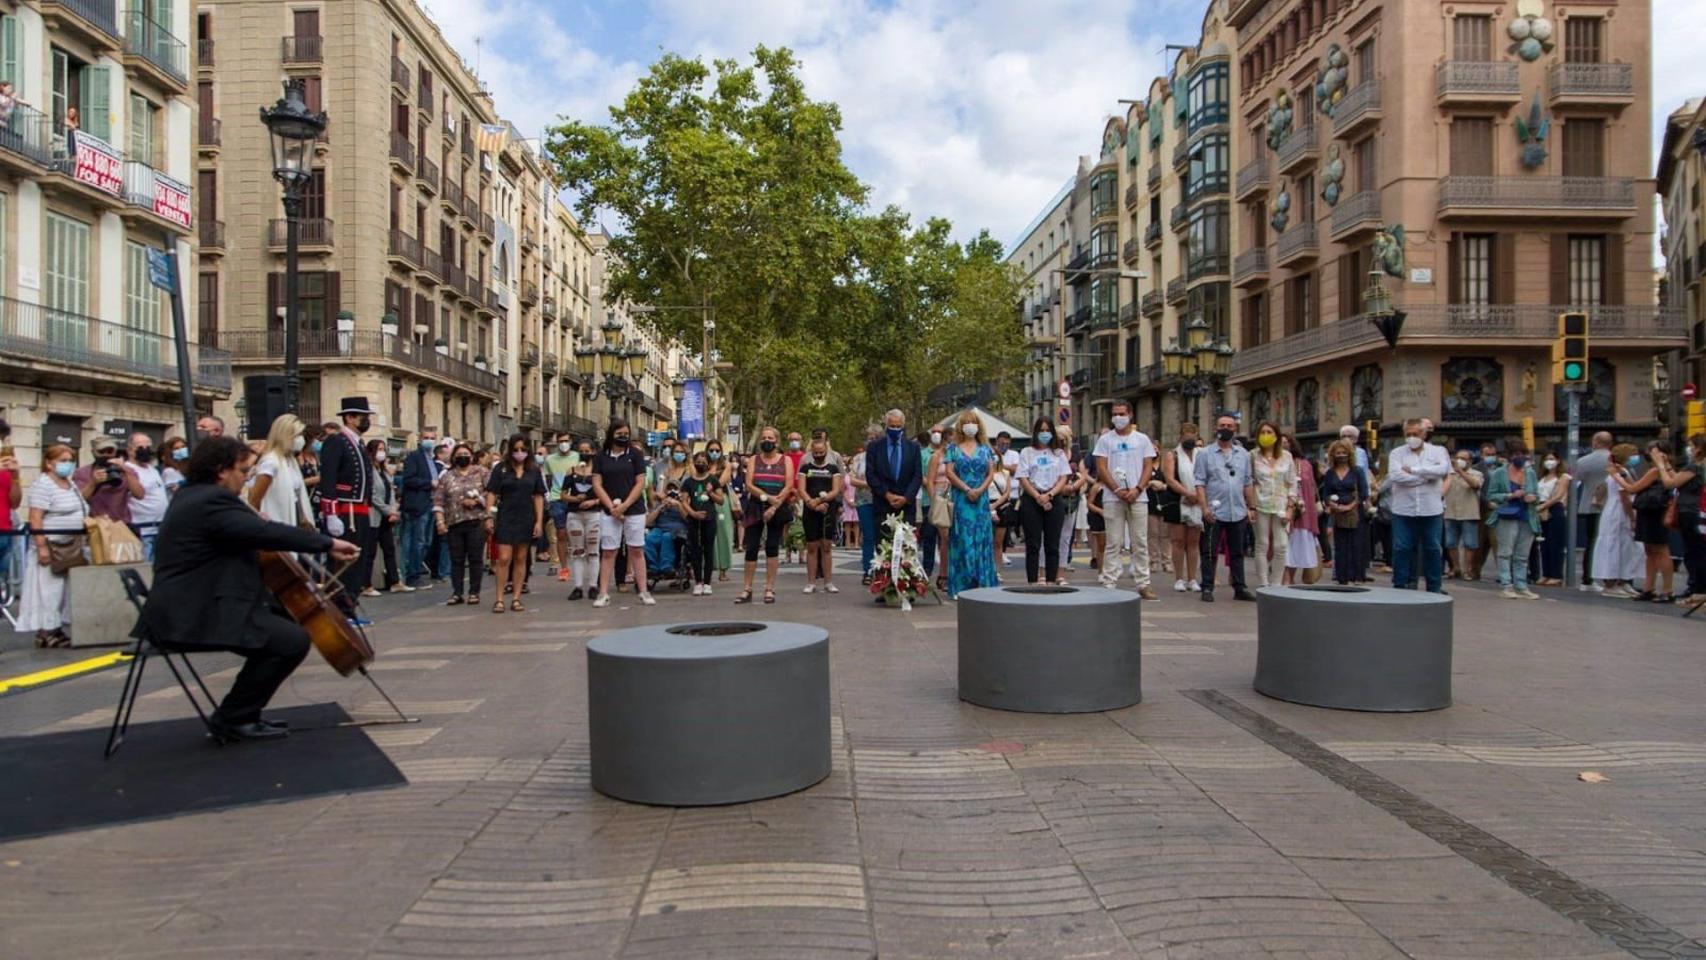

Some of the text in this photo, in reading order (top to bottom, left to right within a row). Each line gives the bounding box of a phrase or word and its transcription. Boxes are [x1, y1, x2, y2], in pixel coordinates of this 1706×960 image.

[79, 166, 121, 193] FOR SALE
[157, 202, 188, 225] VENTA
[109, 427, 125, 435] ATM
